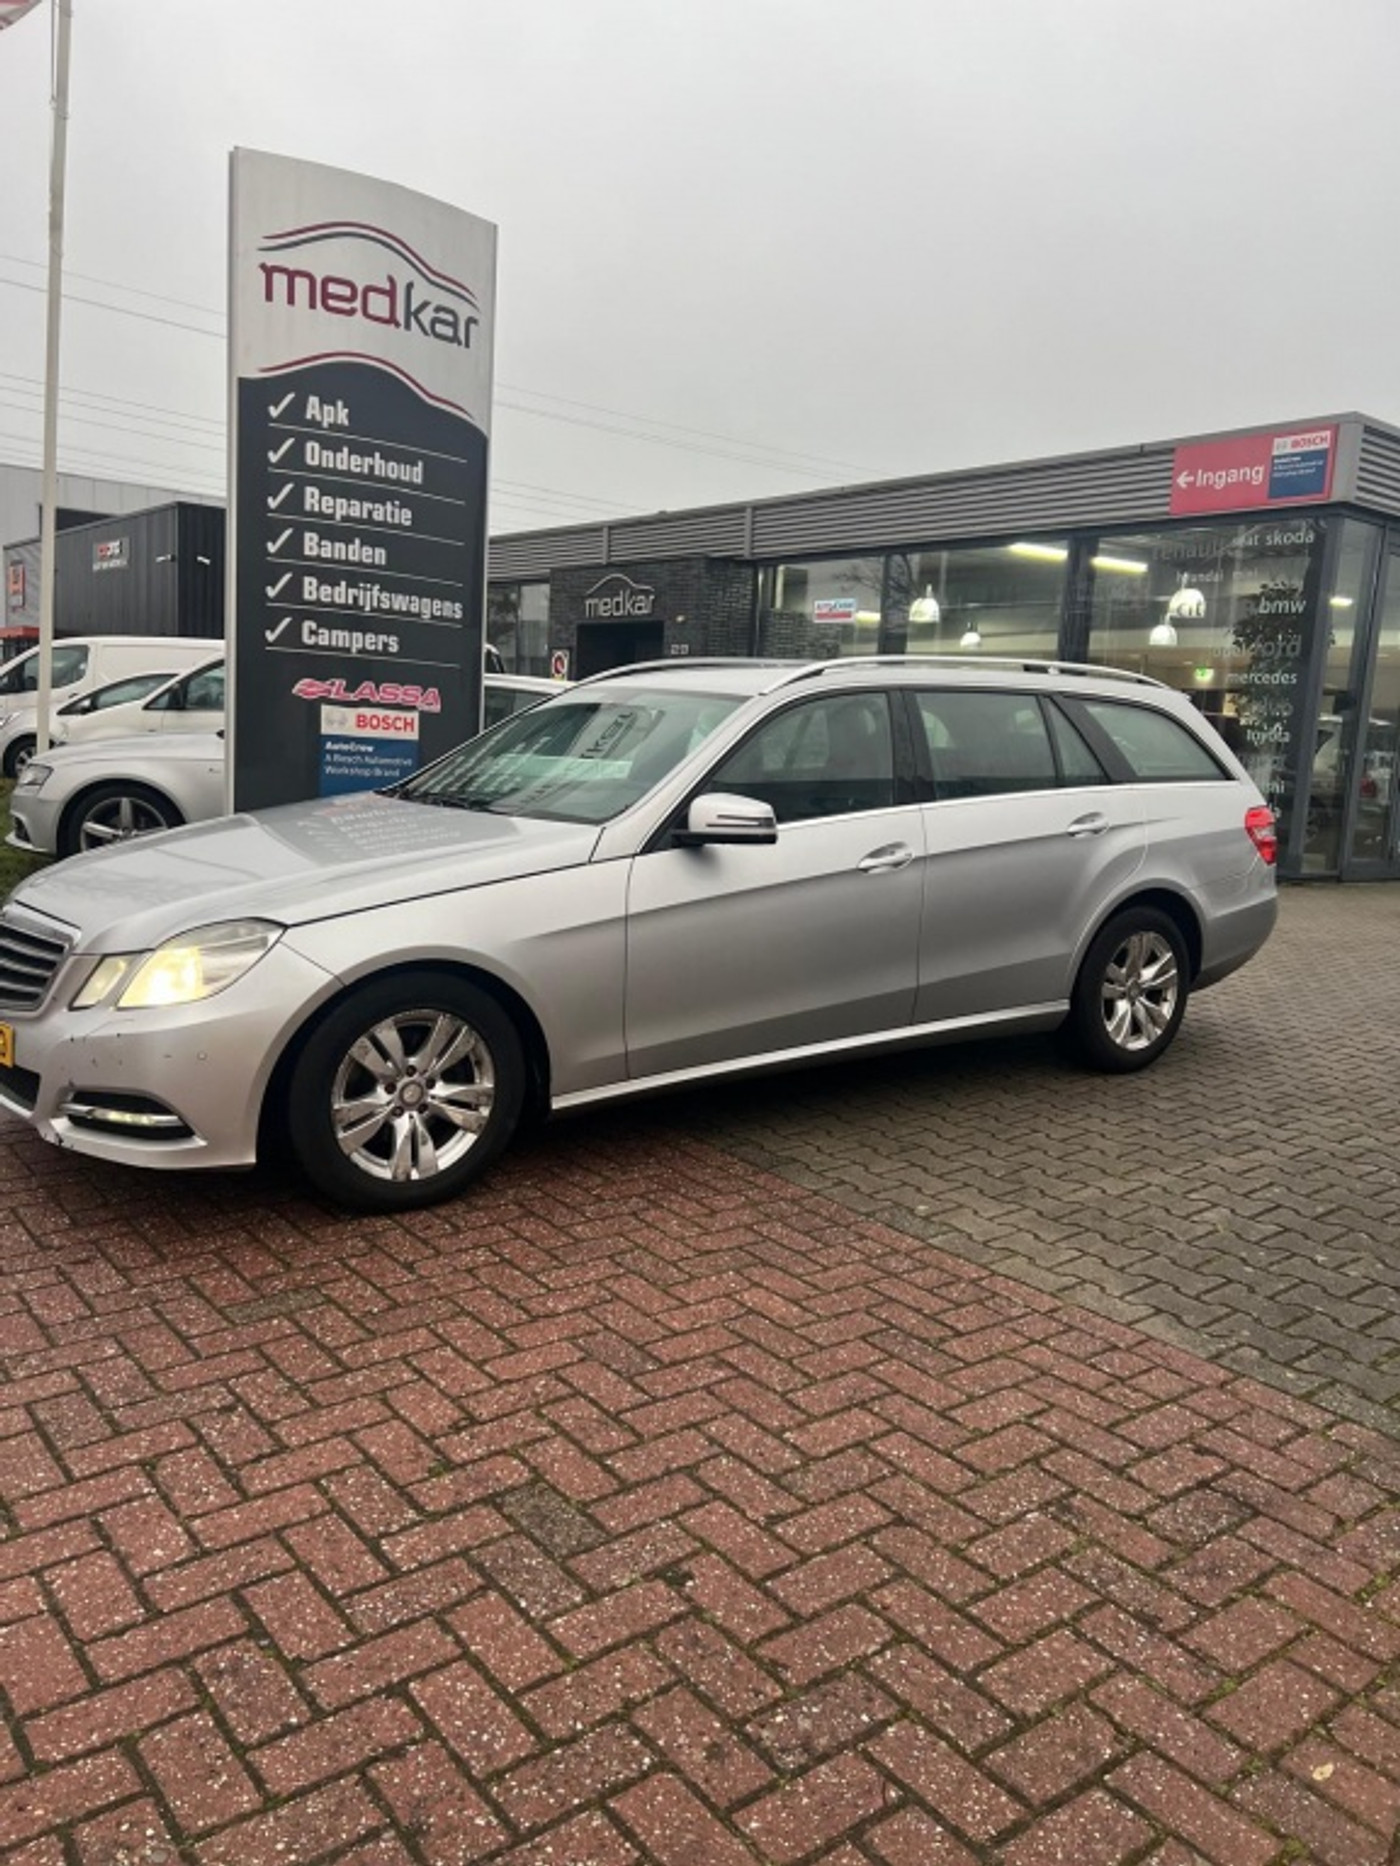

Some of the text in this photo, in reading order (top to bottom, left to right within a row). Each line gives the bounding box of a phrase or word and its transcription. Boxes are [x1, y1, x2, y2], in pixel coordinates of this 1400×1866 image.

[258, 261, 479, 349] medkar
[305, 394, 350, 428] Apk
[304, 440, 424, 485] Onderhoud
[1195, 464, 1265, 490] Ingang
[303, 485, 413, 527] Reparatie
[302, 530, 388, 566] Banden
[1265, 527, 1316, 547] skoda
[302, 575, 464, 620] Bedrijfswagens
[584, 588, 656, 619] medkar
[1259, 596, 1307, 615] bmw
[300, 619, 400, 655] Campers
[1226, 669, 1298, 685] mercedes
[331, 678, 442, 713] LASSA
[355, 714, 416, 733] BOSCH
